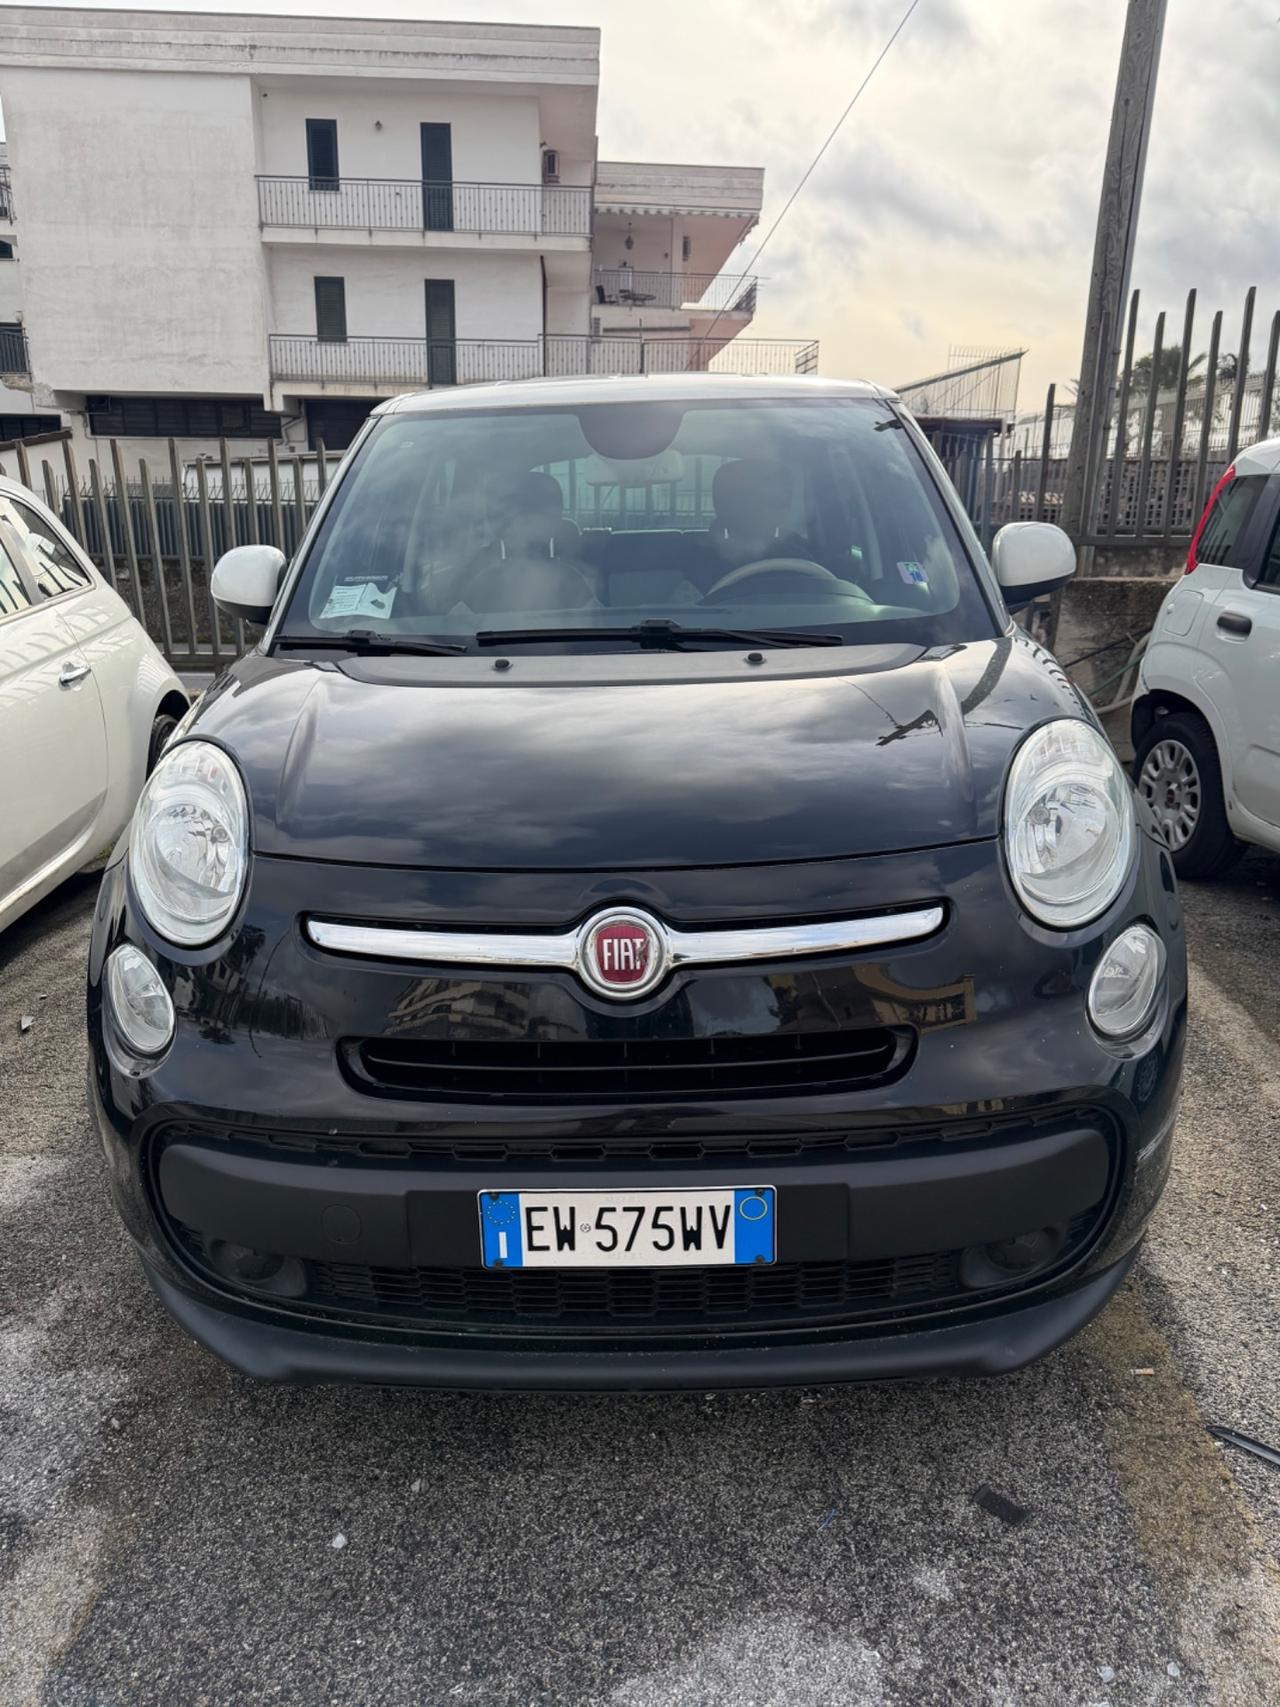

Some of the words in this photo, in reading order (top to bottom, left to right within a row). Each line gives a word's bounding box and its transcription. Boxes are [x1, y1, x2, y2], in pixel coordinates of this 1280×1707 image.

[603, 938, 645, 971] FIAT
[525, 1206, 576, 1251] EW
[594, 1205, 732, 1252] 575WV
[499, 1232, 508, 1259] I
